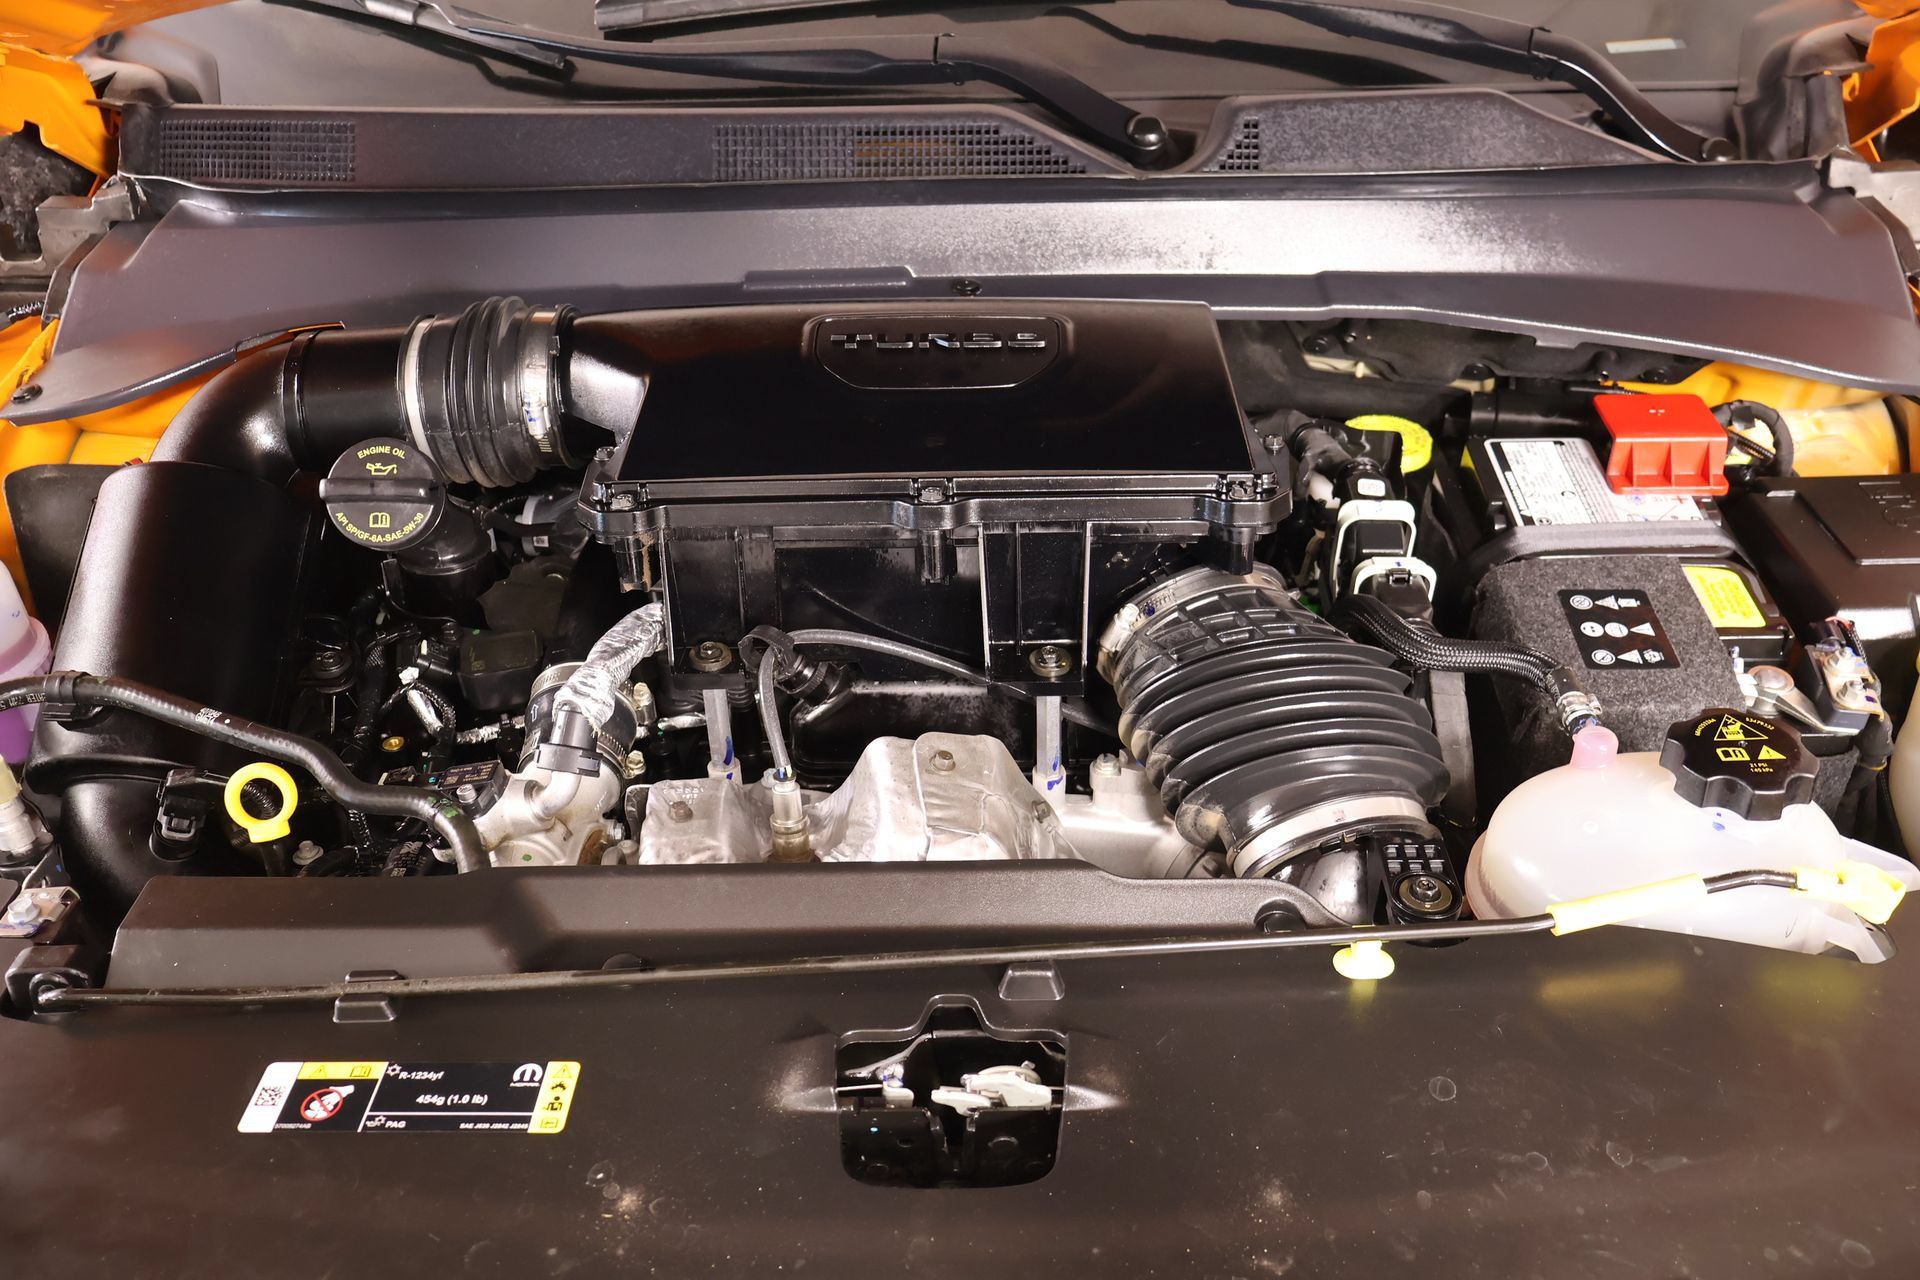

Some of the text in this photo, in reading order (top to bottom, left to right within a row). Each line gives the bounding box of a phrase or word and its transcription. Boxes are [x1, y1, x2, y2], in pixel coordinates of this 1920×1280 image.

[357, 446, 406, 459] ENGINE OIL
[336, 512, 347, 526] API
[399, 1071, 445, 1081] R-1234yf
[415, 1094, 488, 1106] 454g (1.0 lb)
[385, 1120, 407, 1128] PAG
